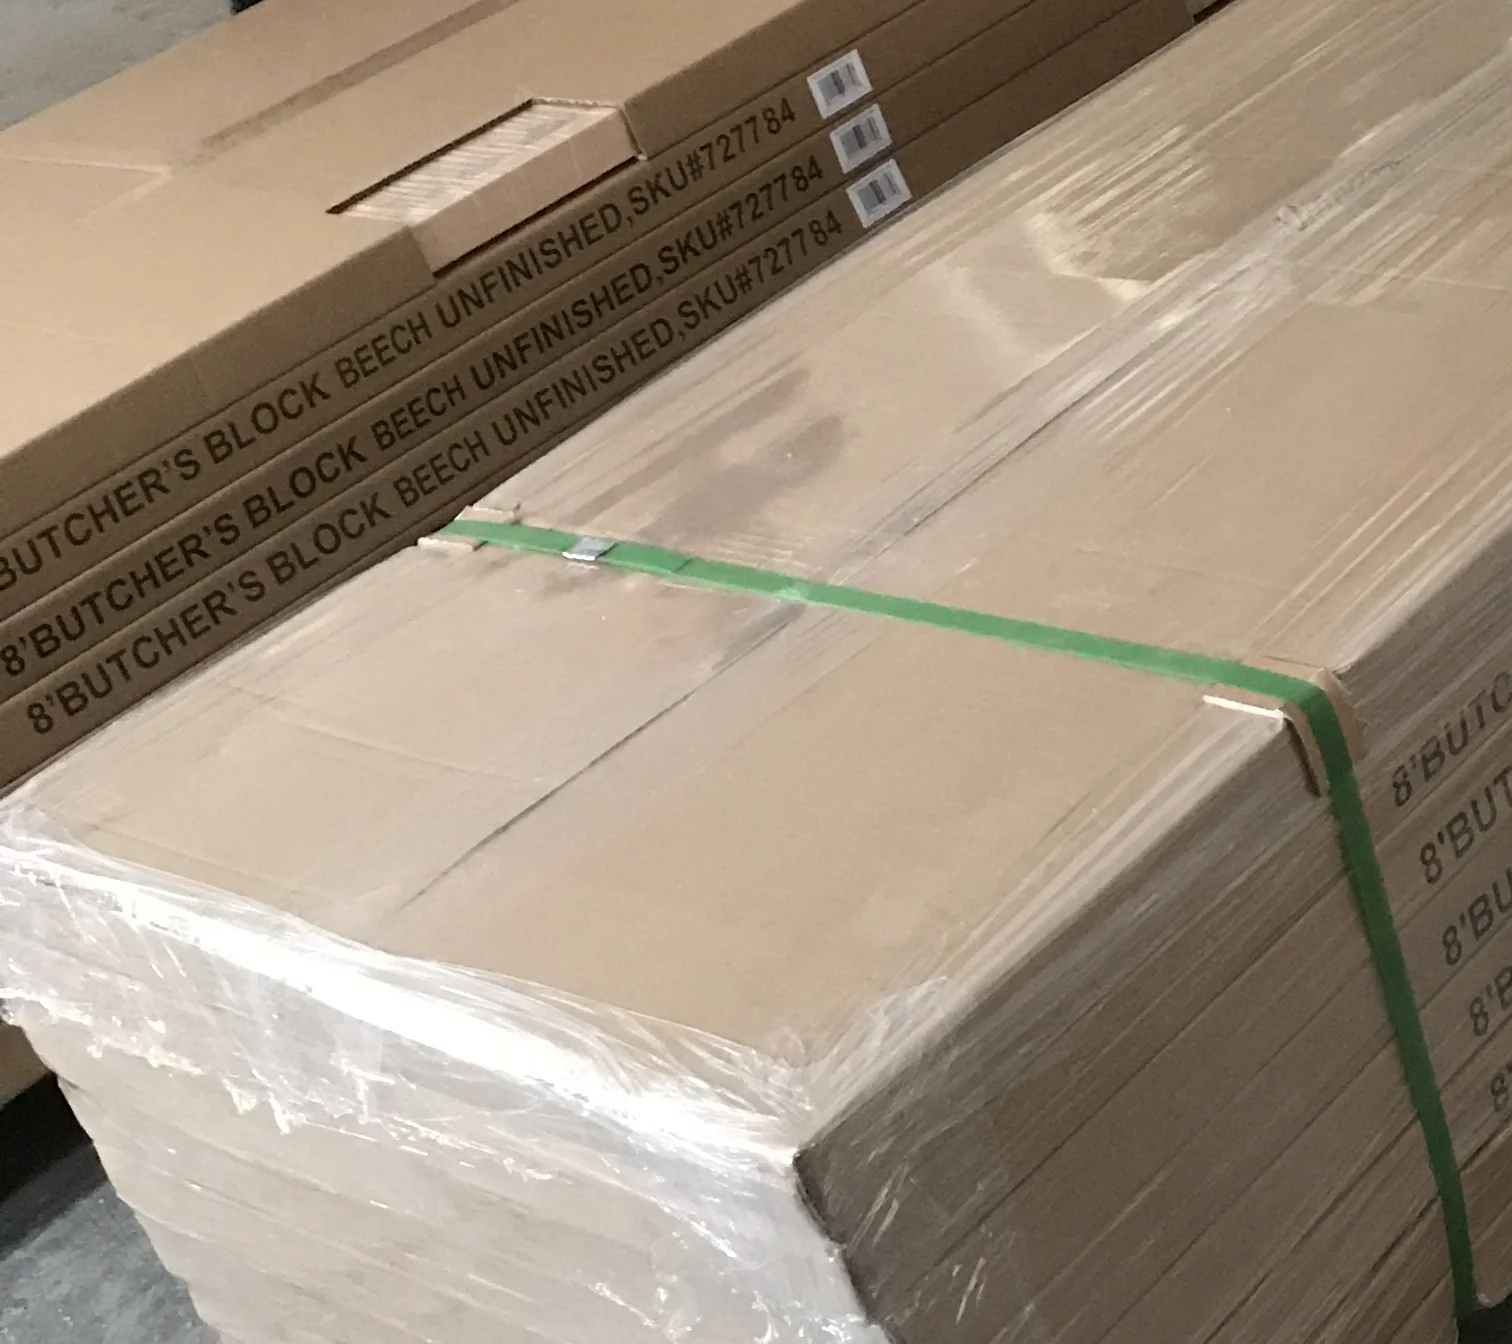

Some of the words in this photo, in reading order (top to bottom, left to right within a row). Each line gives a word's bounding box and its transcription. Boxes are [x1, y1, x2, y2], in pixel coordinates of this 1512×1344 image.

[1, 513, 241, 676] 8'BUTCHER'S
[243, 436, 367, 528] BLOCK
[370, 375, 466, 451] BEECH
[203, 371, 331, 464] BLOCK
[334, 312, 432, 389] BEECH
[27, 570, 265, 734] 8'BUTCHER'S
[267, 492, 391, 585] BLOCK
[393, 430, 490, 506] BEECH
